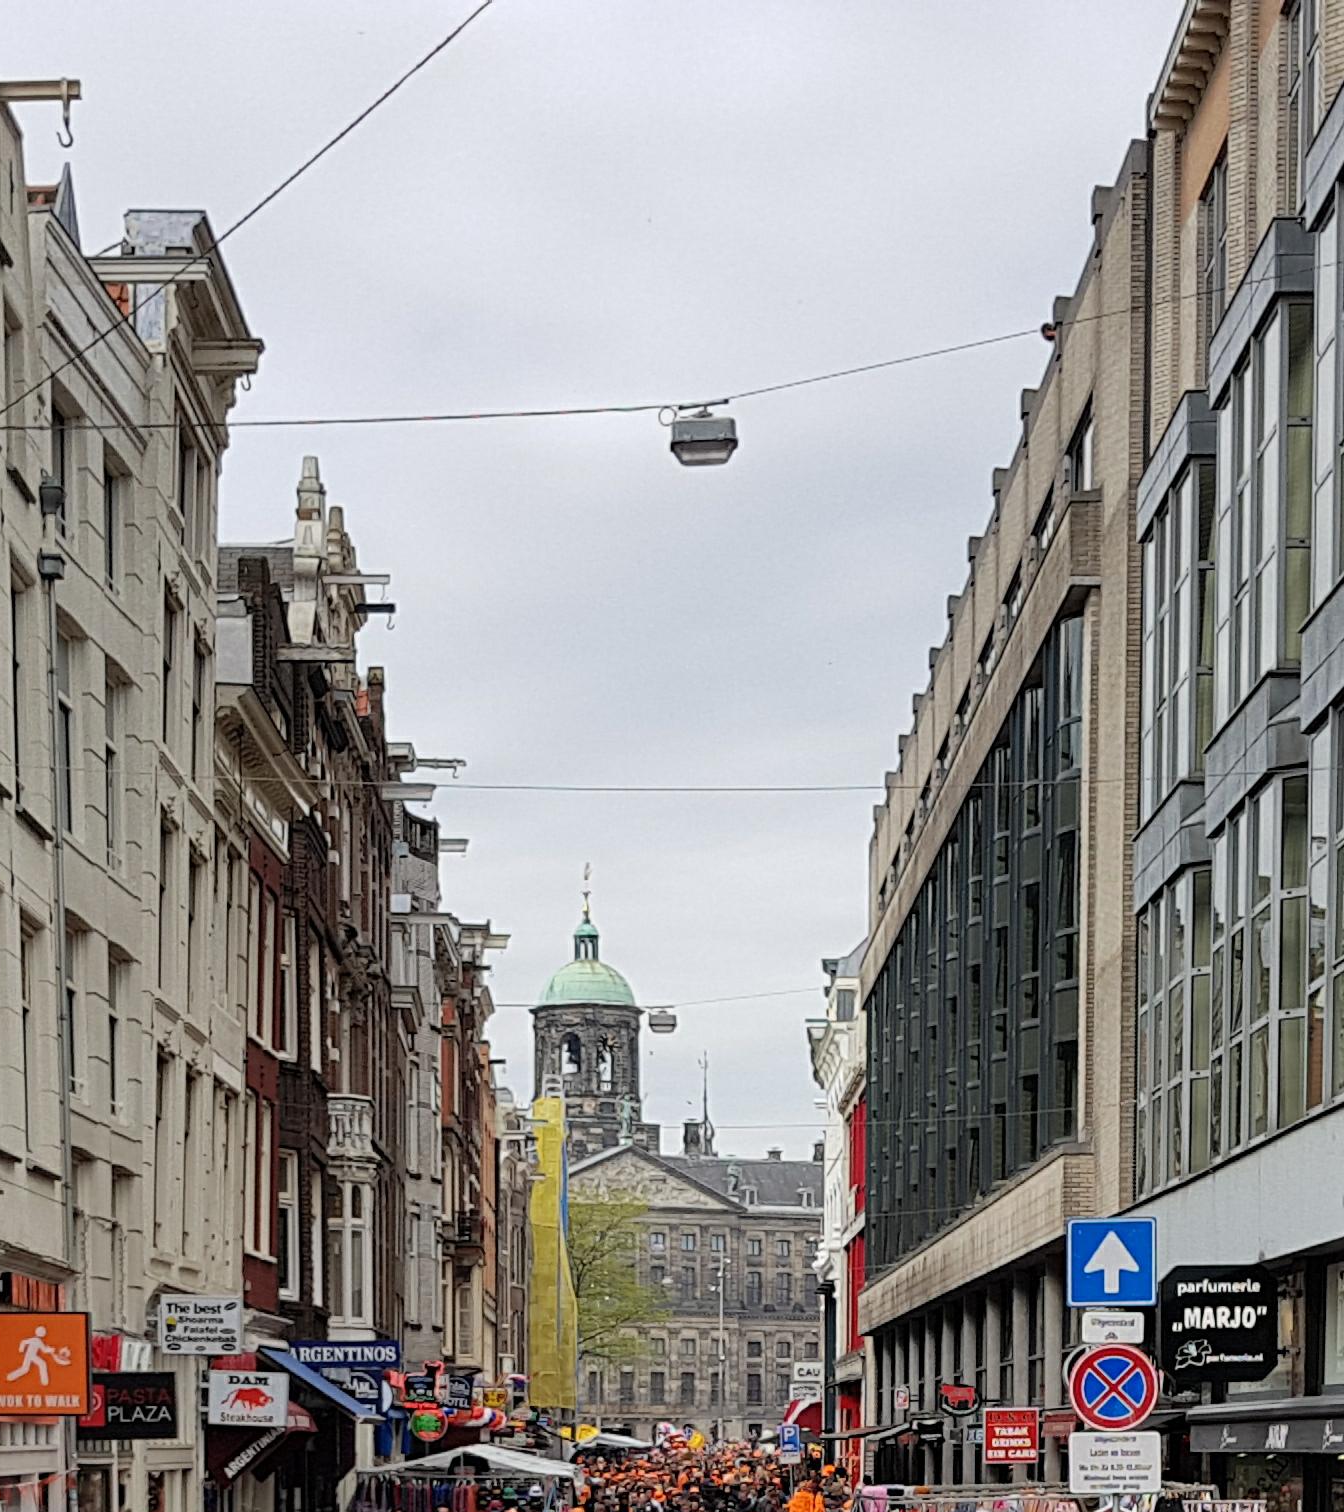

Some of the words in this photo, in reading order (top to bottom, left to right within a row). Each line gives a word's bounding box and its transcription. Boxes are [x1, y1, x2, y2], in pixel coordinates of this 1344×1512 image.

[1177, 1279, 1261, 1296] parfumerie
[166, 1303, 189, 1314] The
[194, 1303, 222, 1314] best
[290, 1346, 397, 1363] ARGENTINOS
[228, 1376, 269, 1385] DAM
[27, 1395, 42, 1408] TO
[46, 1395, 80, 1408] WALK
[108, 1388, 170, 1404] PASTA
[108, 1406, 172, 1422] PLAZA
[220, 1412, 274, 1422] Steakhouse
